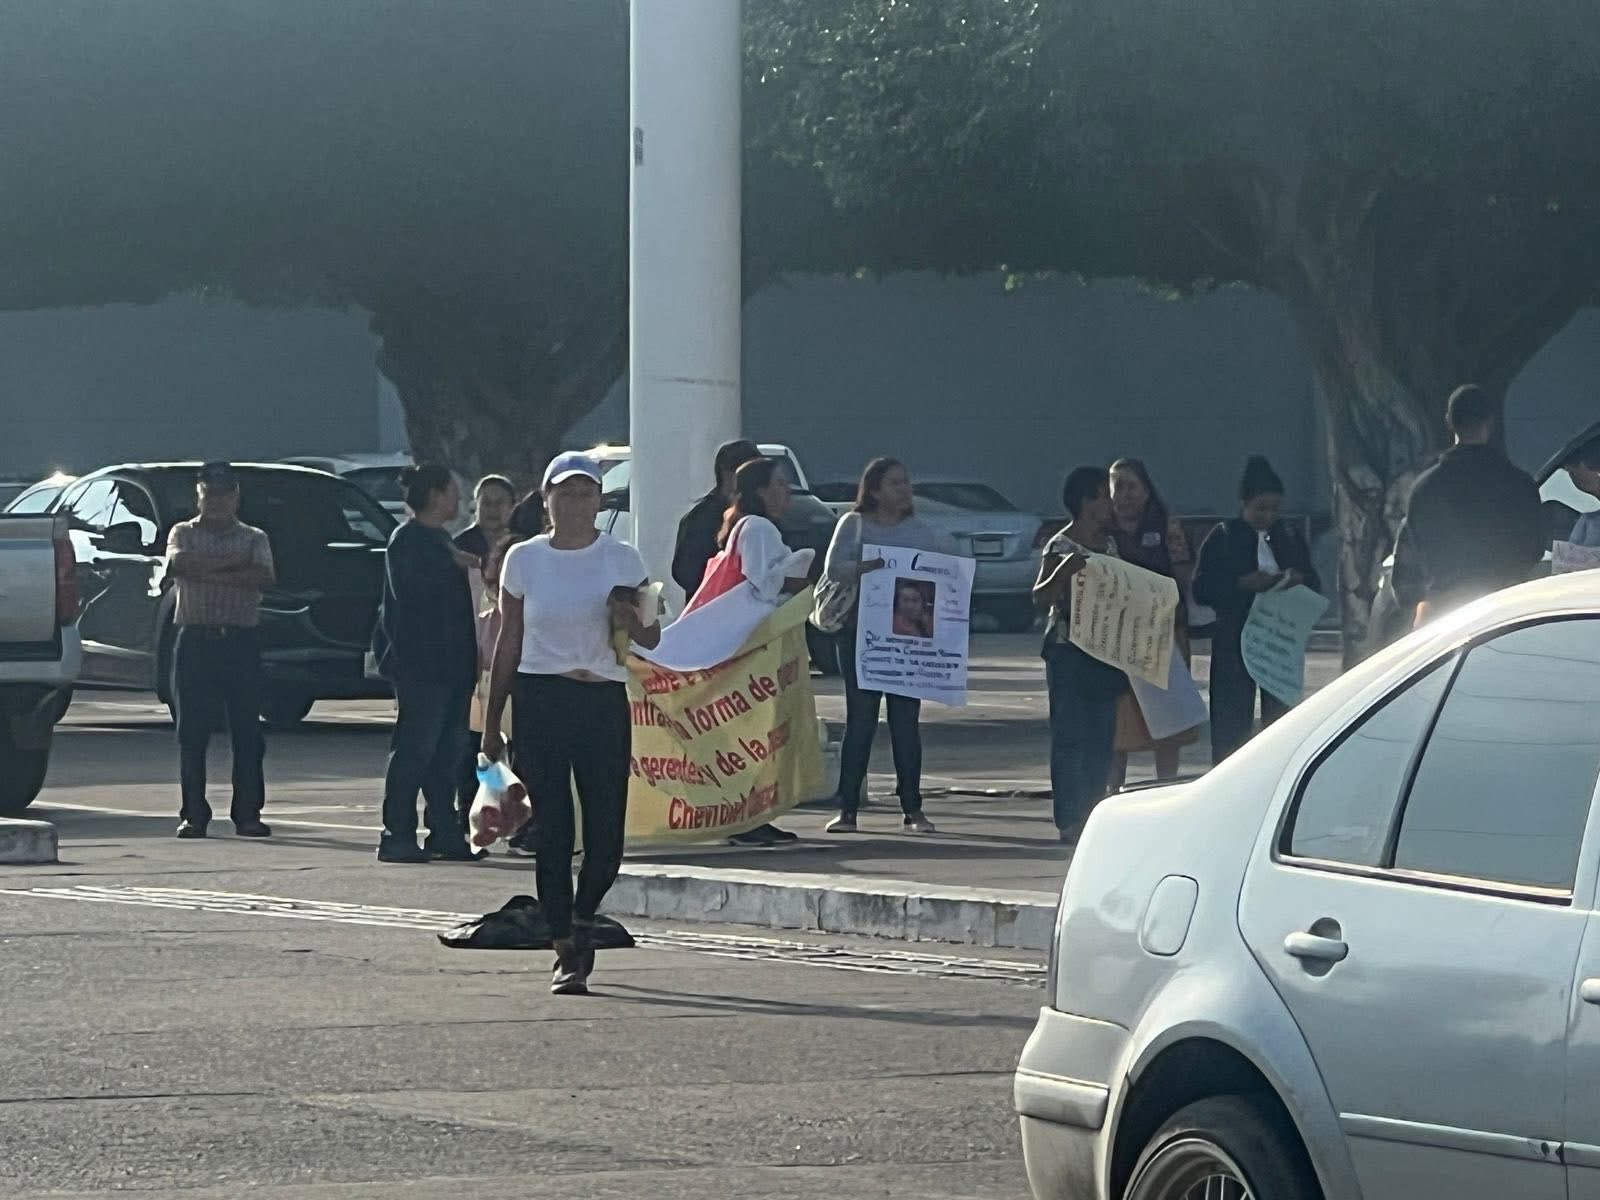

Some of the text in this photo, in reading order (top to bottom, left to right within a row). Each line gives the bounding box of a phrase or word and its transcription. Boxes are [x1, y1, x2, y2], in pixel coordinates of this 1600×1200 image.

[685, 688, 752, 736] forma
[748, 674, 778, 702] de
[715, 750, 747, 778] de
[738, 737, 768, 763] la
